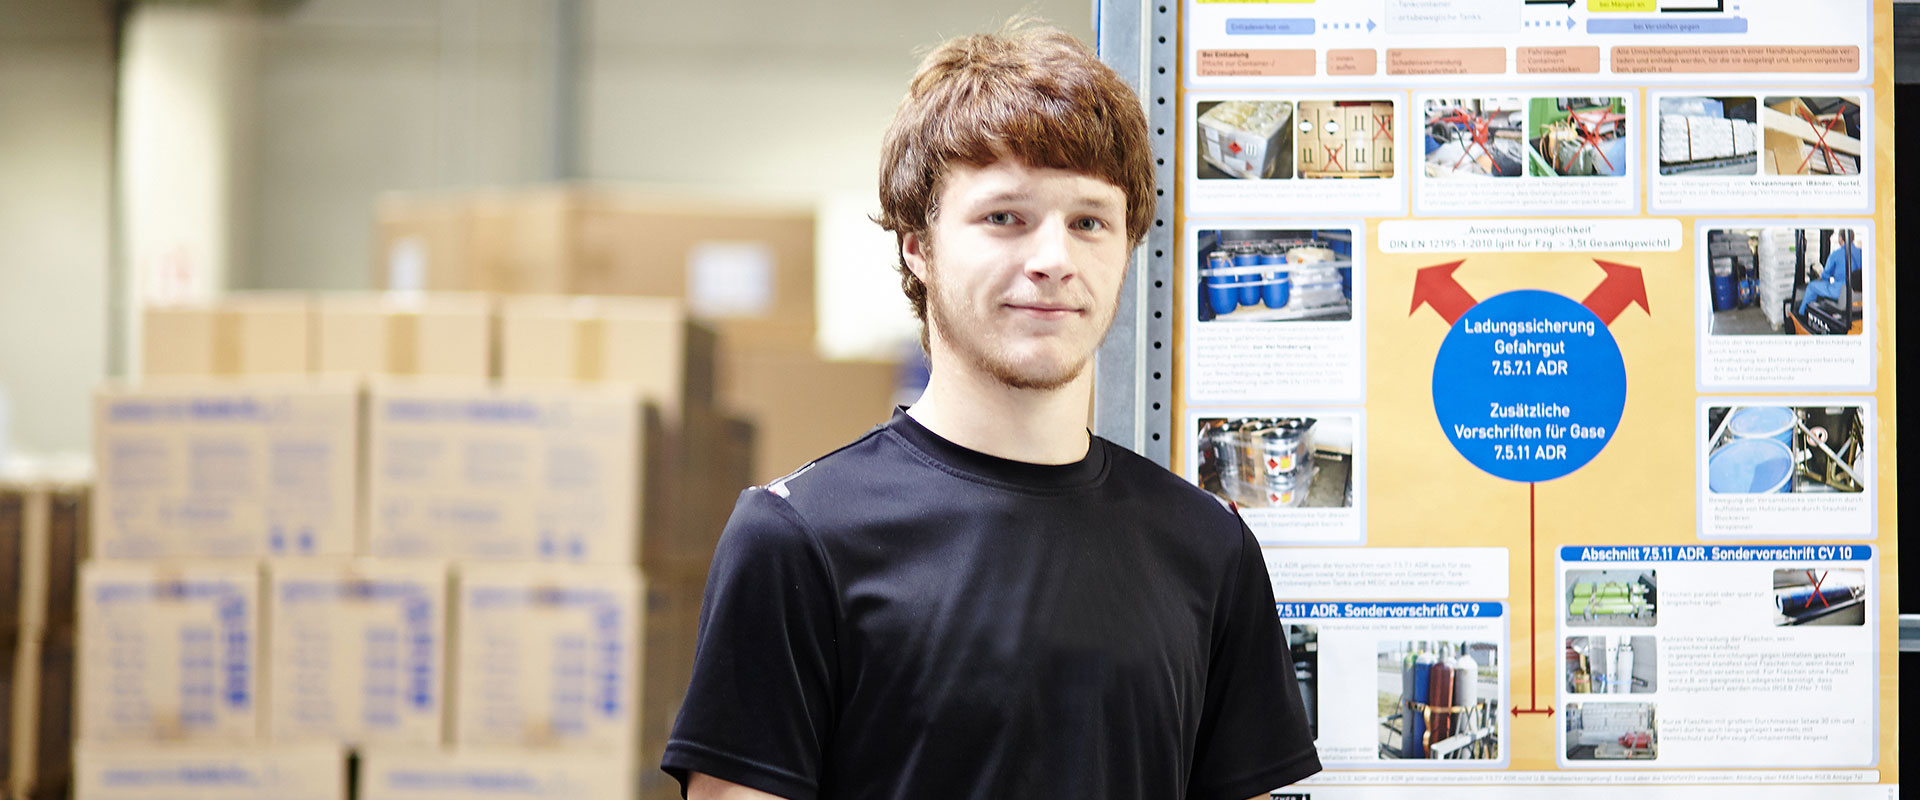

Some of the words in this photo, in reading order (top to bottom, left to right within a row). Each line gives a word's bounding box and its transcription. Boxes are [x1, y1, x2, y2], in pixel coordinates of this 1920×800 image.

[1389, 239, 1407, 248] DIN
[1411, 239, 1425, 248] EN
[1589, 238, 1671, 250] Gesamtgewicht)
[1464, 318, 1595, 337] Ladungssicherung
[1494, 339, 1565, 357] Gefahrgut
[1491, 360, 1531, 376] 7.5.7.1
[1536, 360, 1568, 376] ADR
[1490, 402, 1570, 418] Zusätzliche
[1454, 423, 1541, 439] Vorschriften
[1545, 423, 1567, 439] für
[1570, 423, 1606, 439] Gase
[1494, 444, 1530, 460] 7.5.11
[1534, 444, 1567, 460] ADR
[1581, 547, 1640, 560] Abschnitt
[1643, 547, 1672, 560] 7.5.11
[1677, 547, 1708, 561] ADR,
[1712, 547, 1815, 560] Sondervorschrift
[1818, 547, 1836, 560] CV
[1839, 547, 1852, 560] 10
[1276, 604, 1306, 617] 7.5.11
[1345, 604, 1449, 617] Sondervorschrift
[1452, 604, 1469, 617] CV
[1472, 604, 1480, 617] 9
